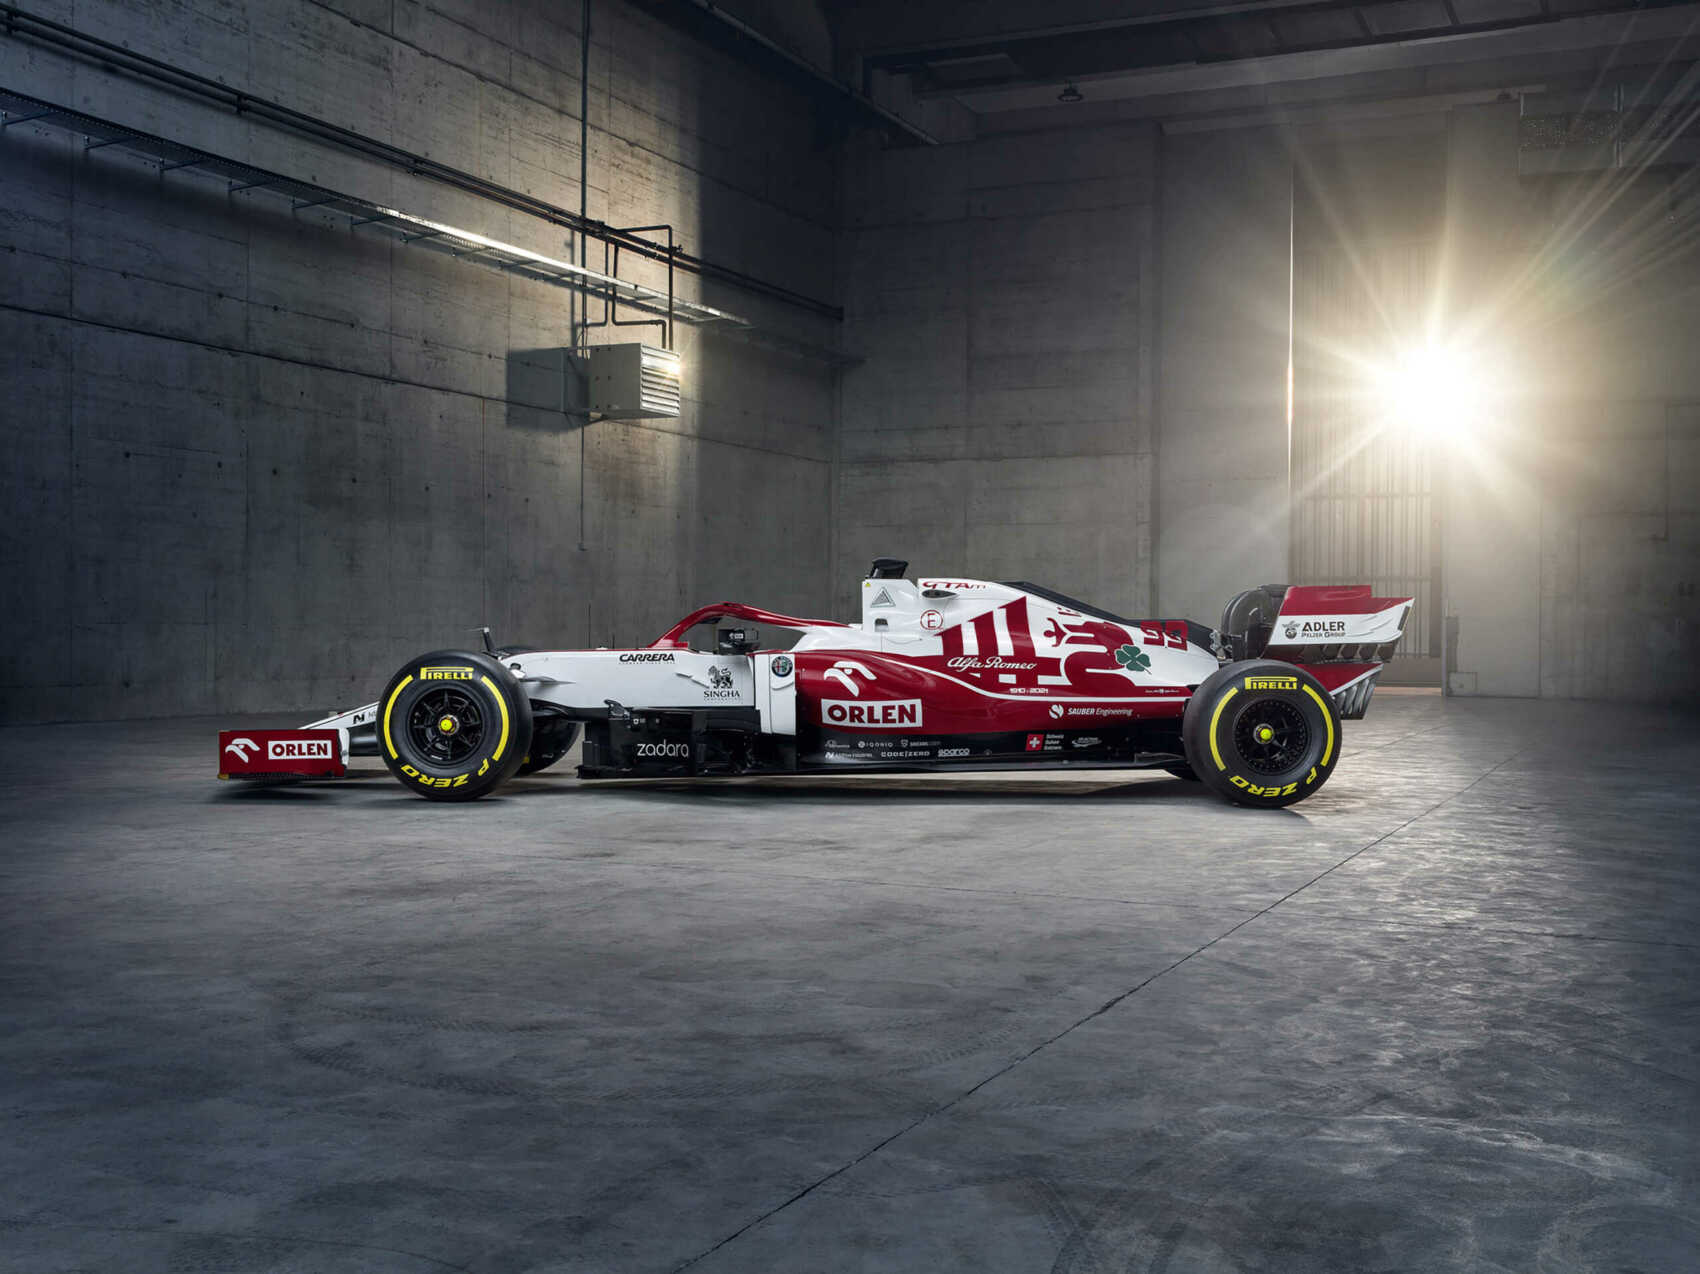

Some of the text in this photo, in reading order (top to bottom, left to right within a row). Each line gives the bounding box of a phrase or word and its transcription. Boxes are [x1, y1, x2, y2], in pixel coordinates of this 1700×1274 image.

[1302, 621, 1345, 632] ADLER
[619, 653, 675, 662] CARRERA
[946, 656, 1037, 673] Alfa Romeo
[420, 666, 474, 680] PIRELLI
[1245, 676, 1298, 690] PIRELLI
[703, 690, 740, 698] SINGHA
[827, 703, 917, 724] ORLEN
[1067, 707, 1096, 716] SAUBER
[271, 742, 329, 757] ORLEN
[637, 738, 689, 758] zadara
[400, 758, 490, 788] P ZERO
[1229, 766, 1318, 798] P ZERO
